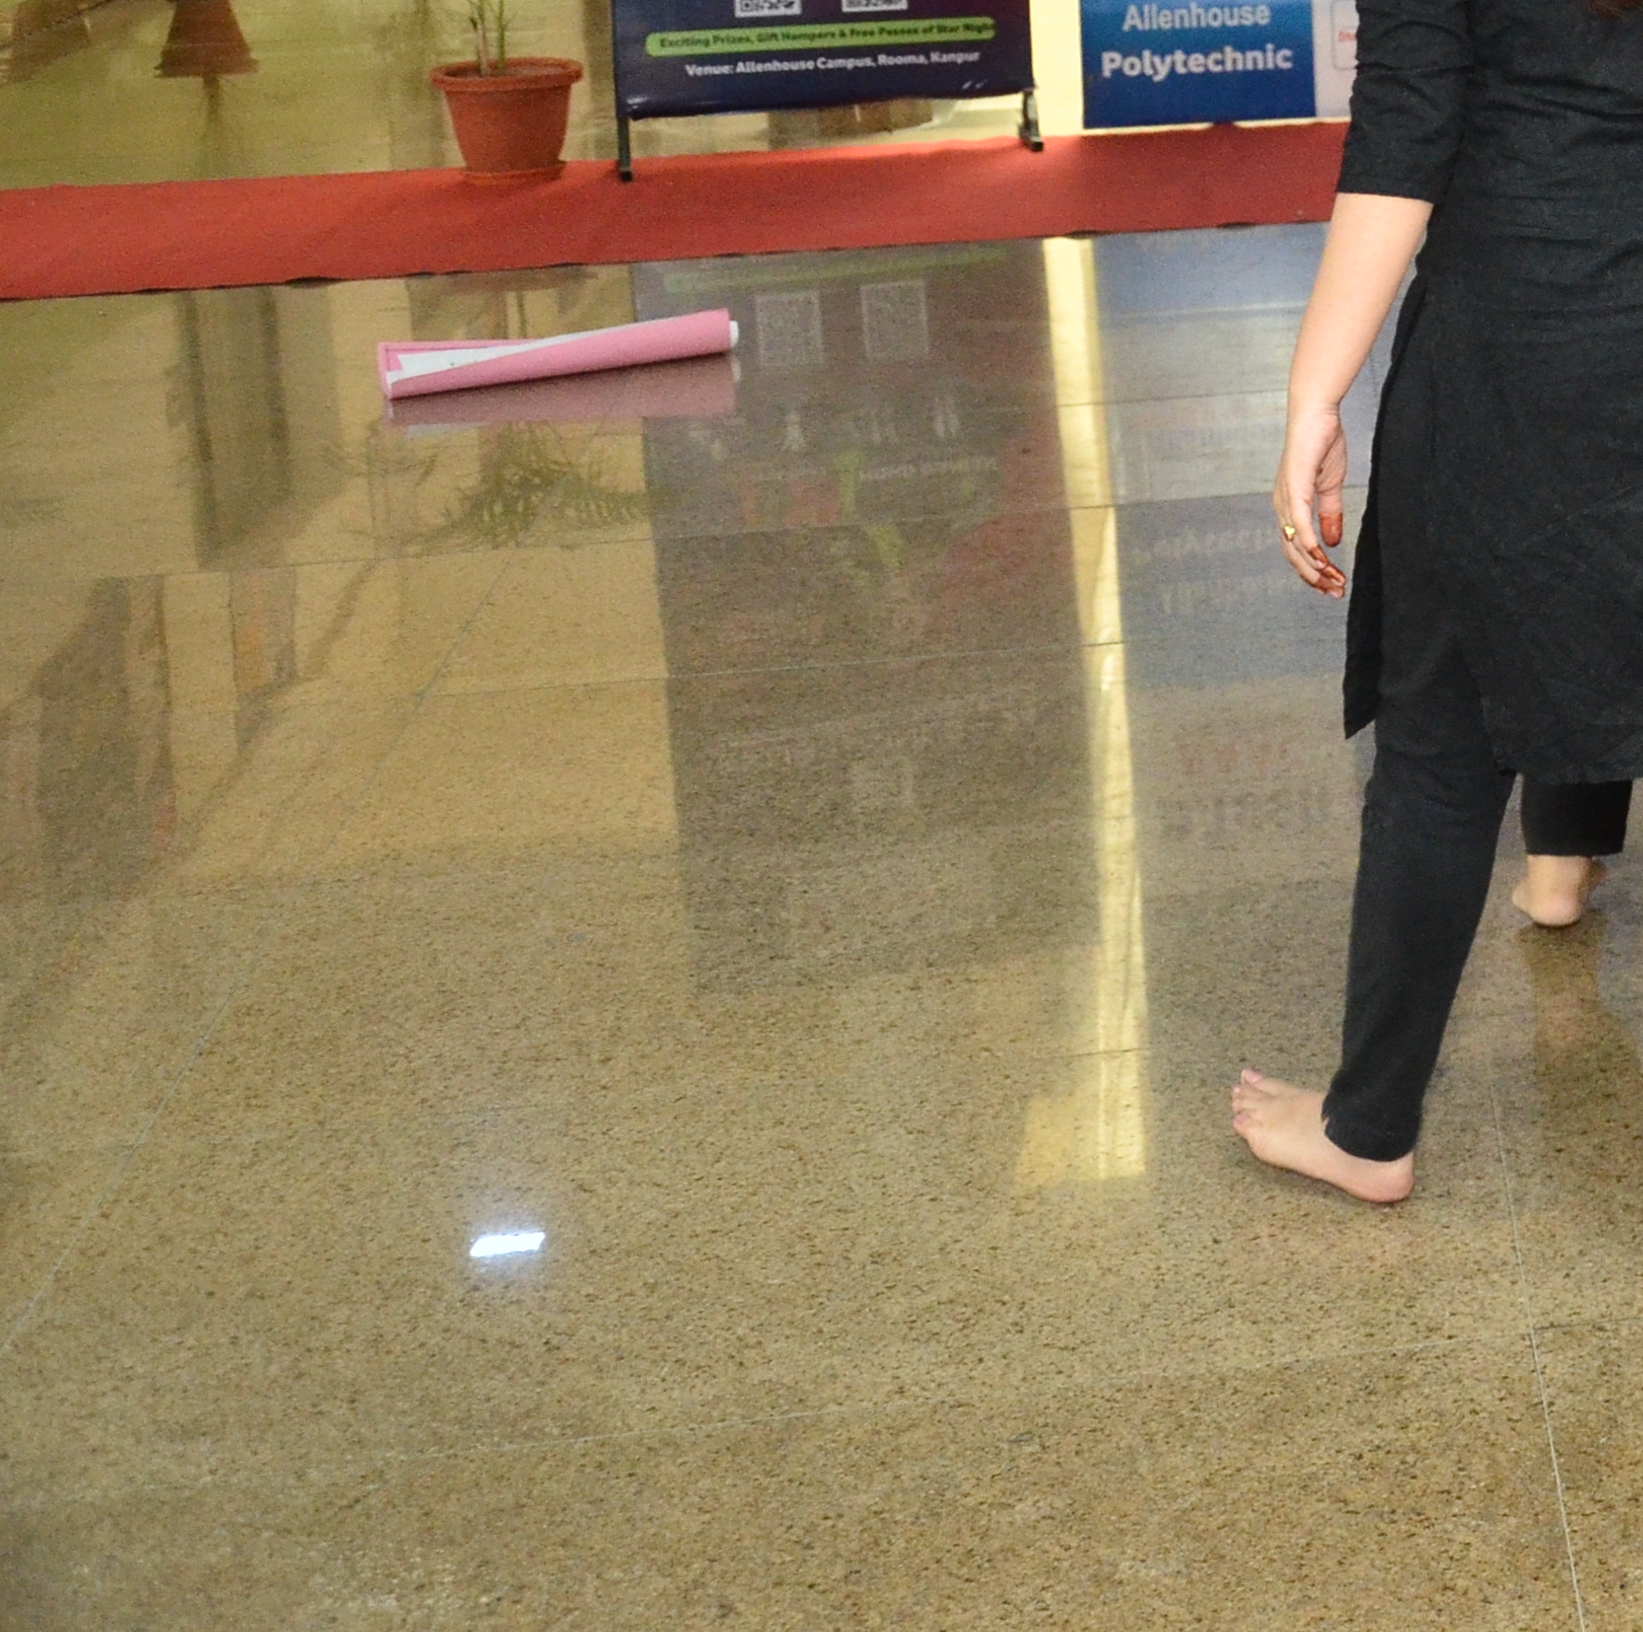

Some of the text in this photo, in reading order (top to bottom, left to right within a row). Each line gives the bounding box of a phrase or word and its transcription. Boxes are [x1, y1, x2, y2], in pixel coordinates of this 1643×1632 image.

[1122, 2, 1271, 32] Allenhouse
[735, 60, 815, 74] Allenhouse
[1101, 43, 1294, 82] Polytechnic
